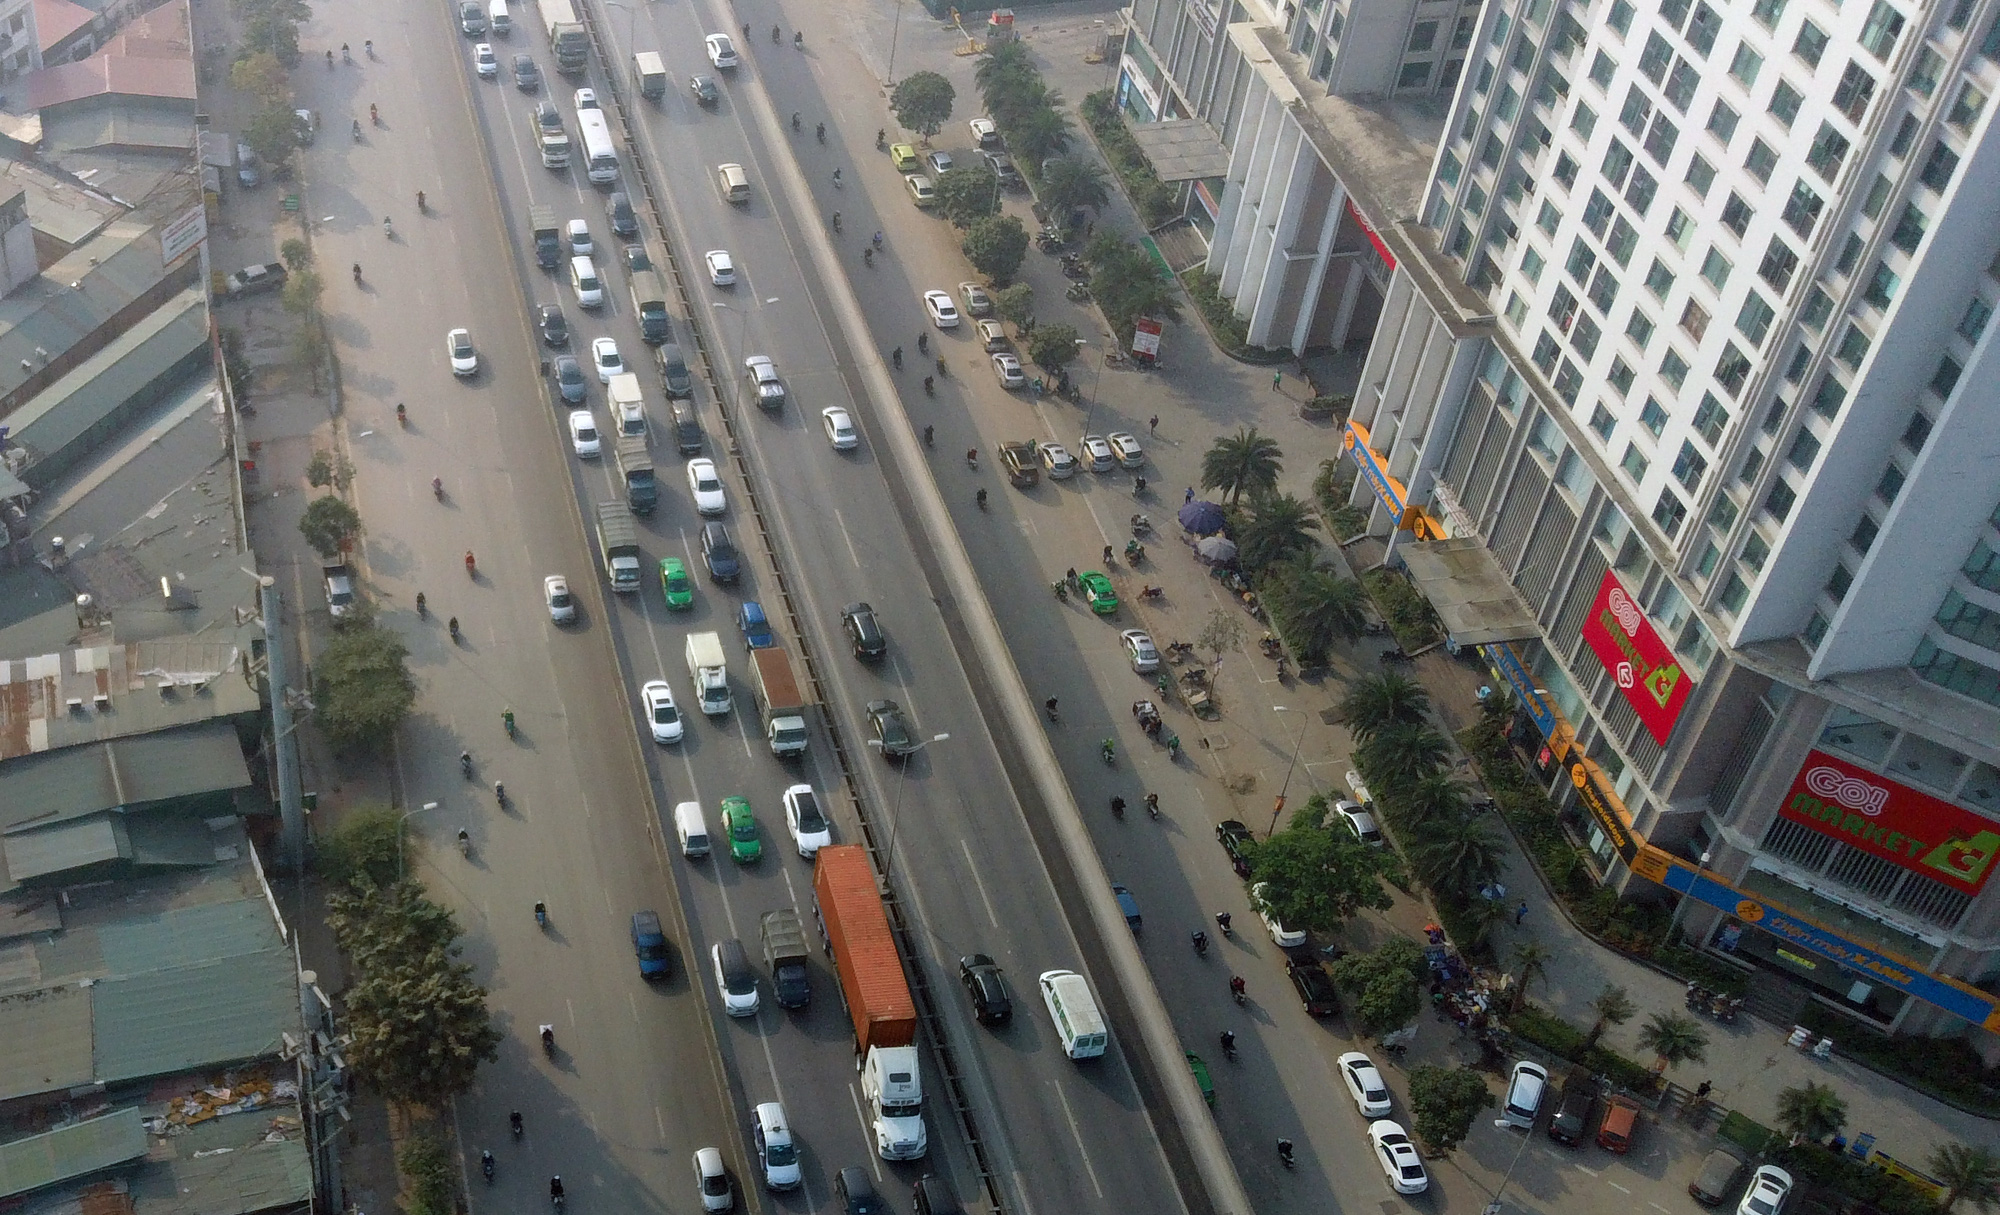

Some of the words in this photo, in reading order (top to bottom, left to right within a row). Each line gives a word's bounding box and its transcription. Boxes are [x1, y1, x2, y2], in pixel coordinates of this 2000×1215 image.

[1608, 587, 1641, 637] GO!
[1600, 608, 1649, 678] MARKET
[1806, 766, 1889, 816] GO!
[1791, 793, 1927, 858] MARKET
